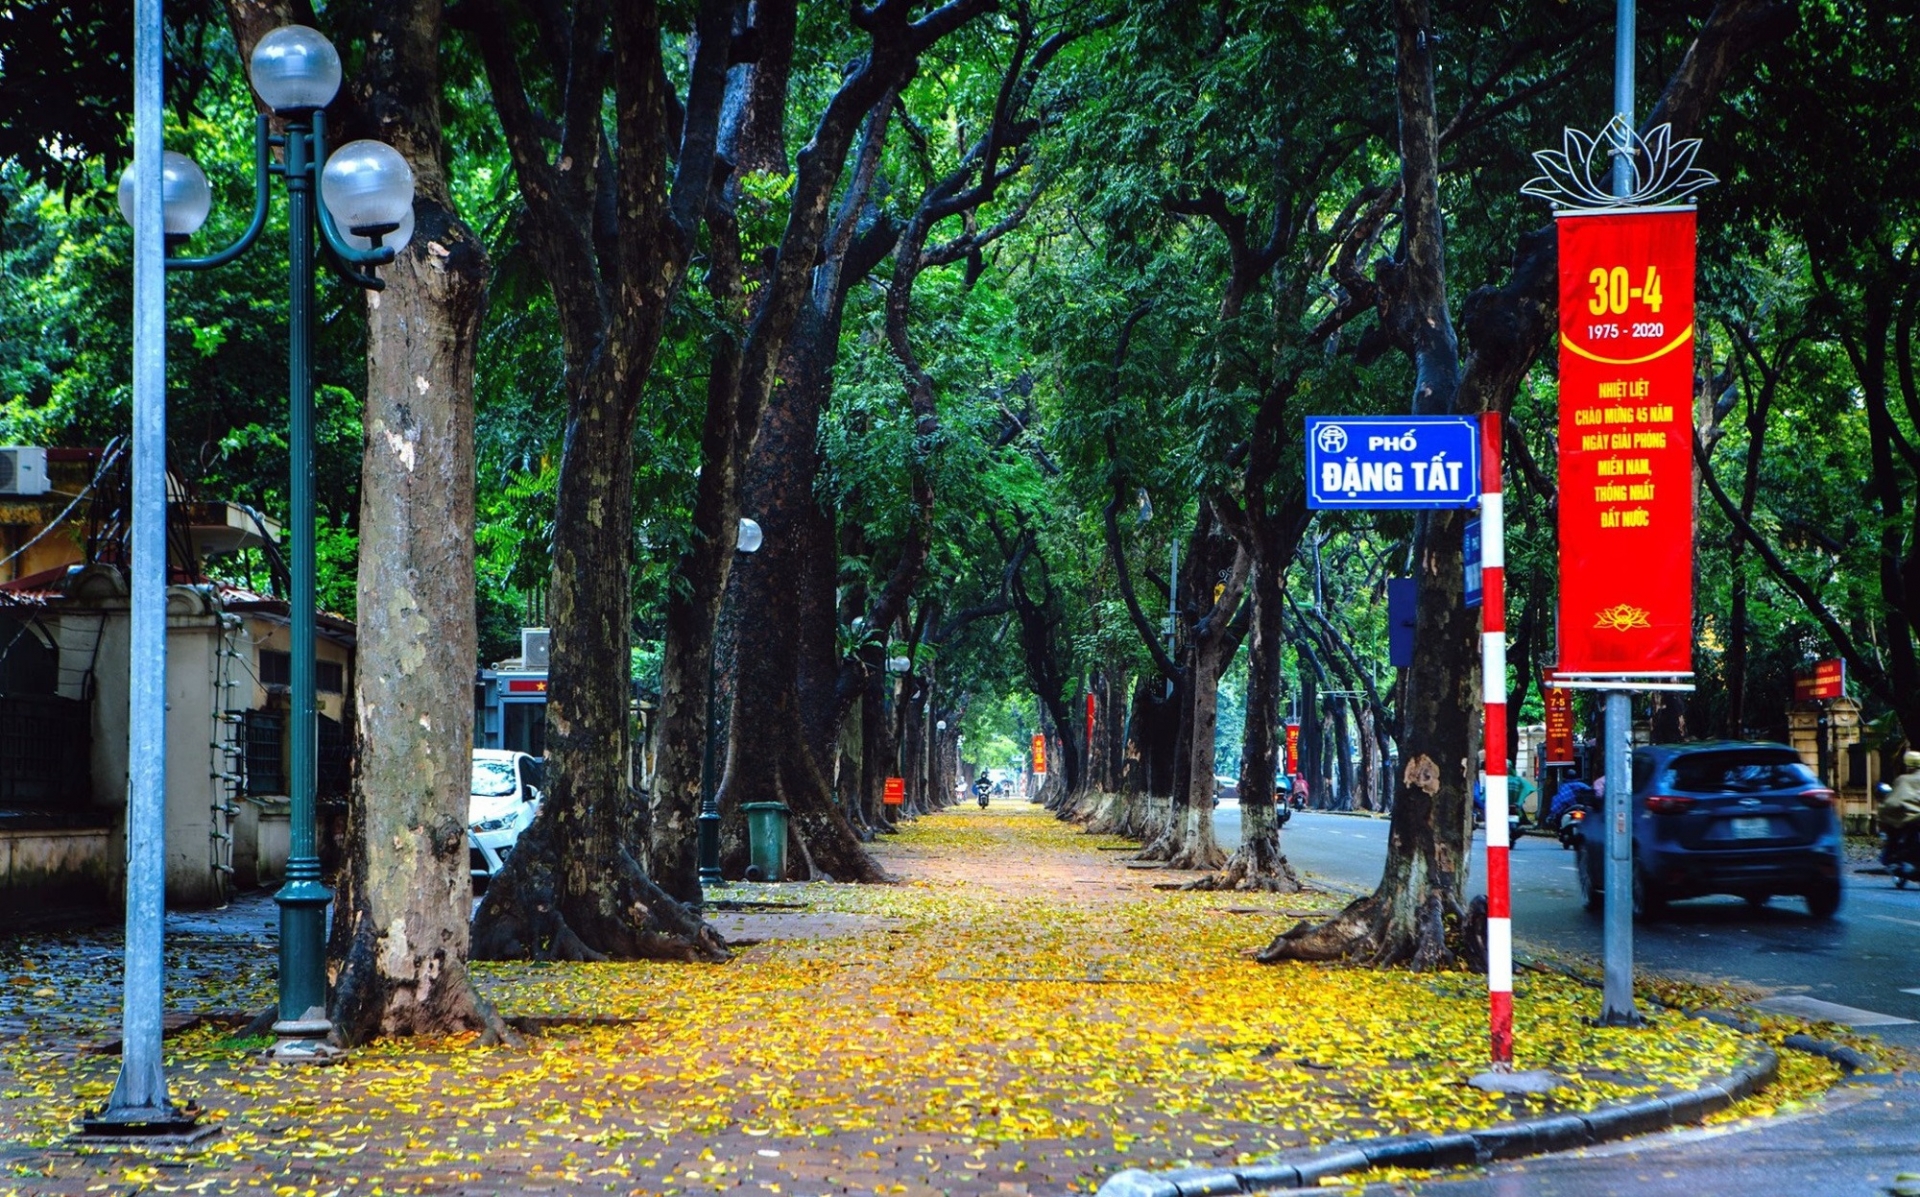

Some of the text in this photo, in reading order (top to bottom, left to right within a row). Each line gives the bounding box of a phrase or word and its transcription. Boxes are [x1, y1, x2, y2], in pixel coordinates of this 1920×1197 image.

[1588, 265, 1663, 316] 30-4
[1588, 323, 1619, 340] 1975
[1631, 322, 1664, 338] 2020
[1598, 377, 1650, 401] NHIỆT LIỆT
[1575, 403, 1673, 426] CHÀO MỪNG 45 NĂM
[1368, 428, 1417, 451] PHỐ
[1582, 426, 1666, 451] NGÀY GIẢI PHÓNG
[1322, 451, 1463, 497] ĐẶNG TẤT
[1626, 458, 1652, 476] NAM,
[1594, 478, 1655, 502] THỐNG NHẤT
[1600, 505, 1650, 528] ĐẤT NƯỚC
[1550, 698, 1565, 706] 7-5
